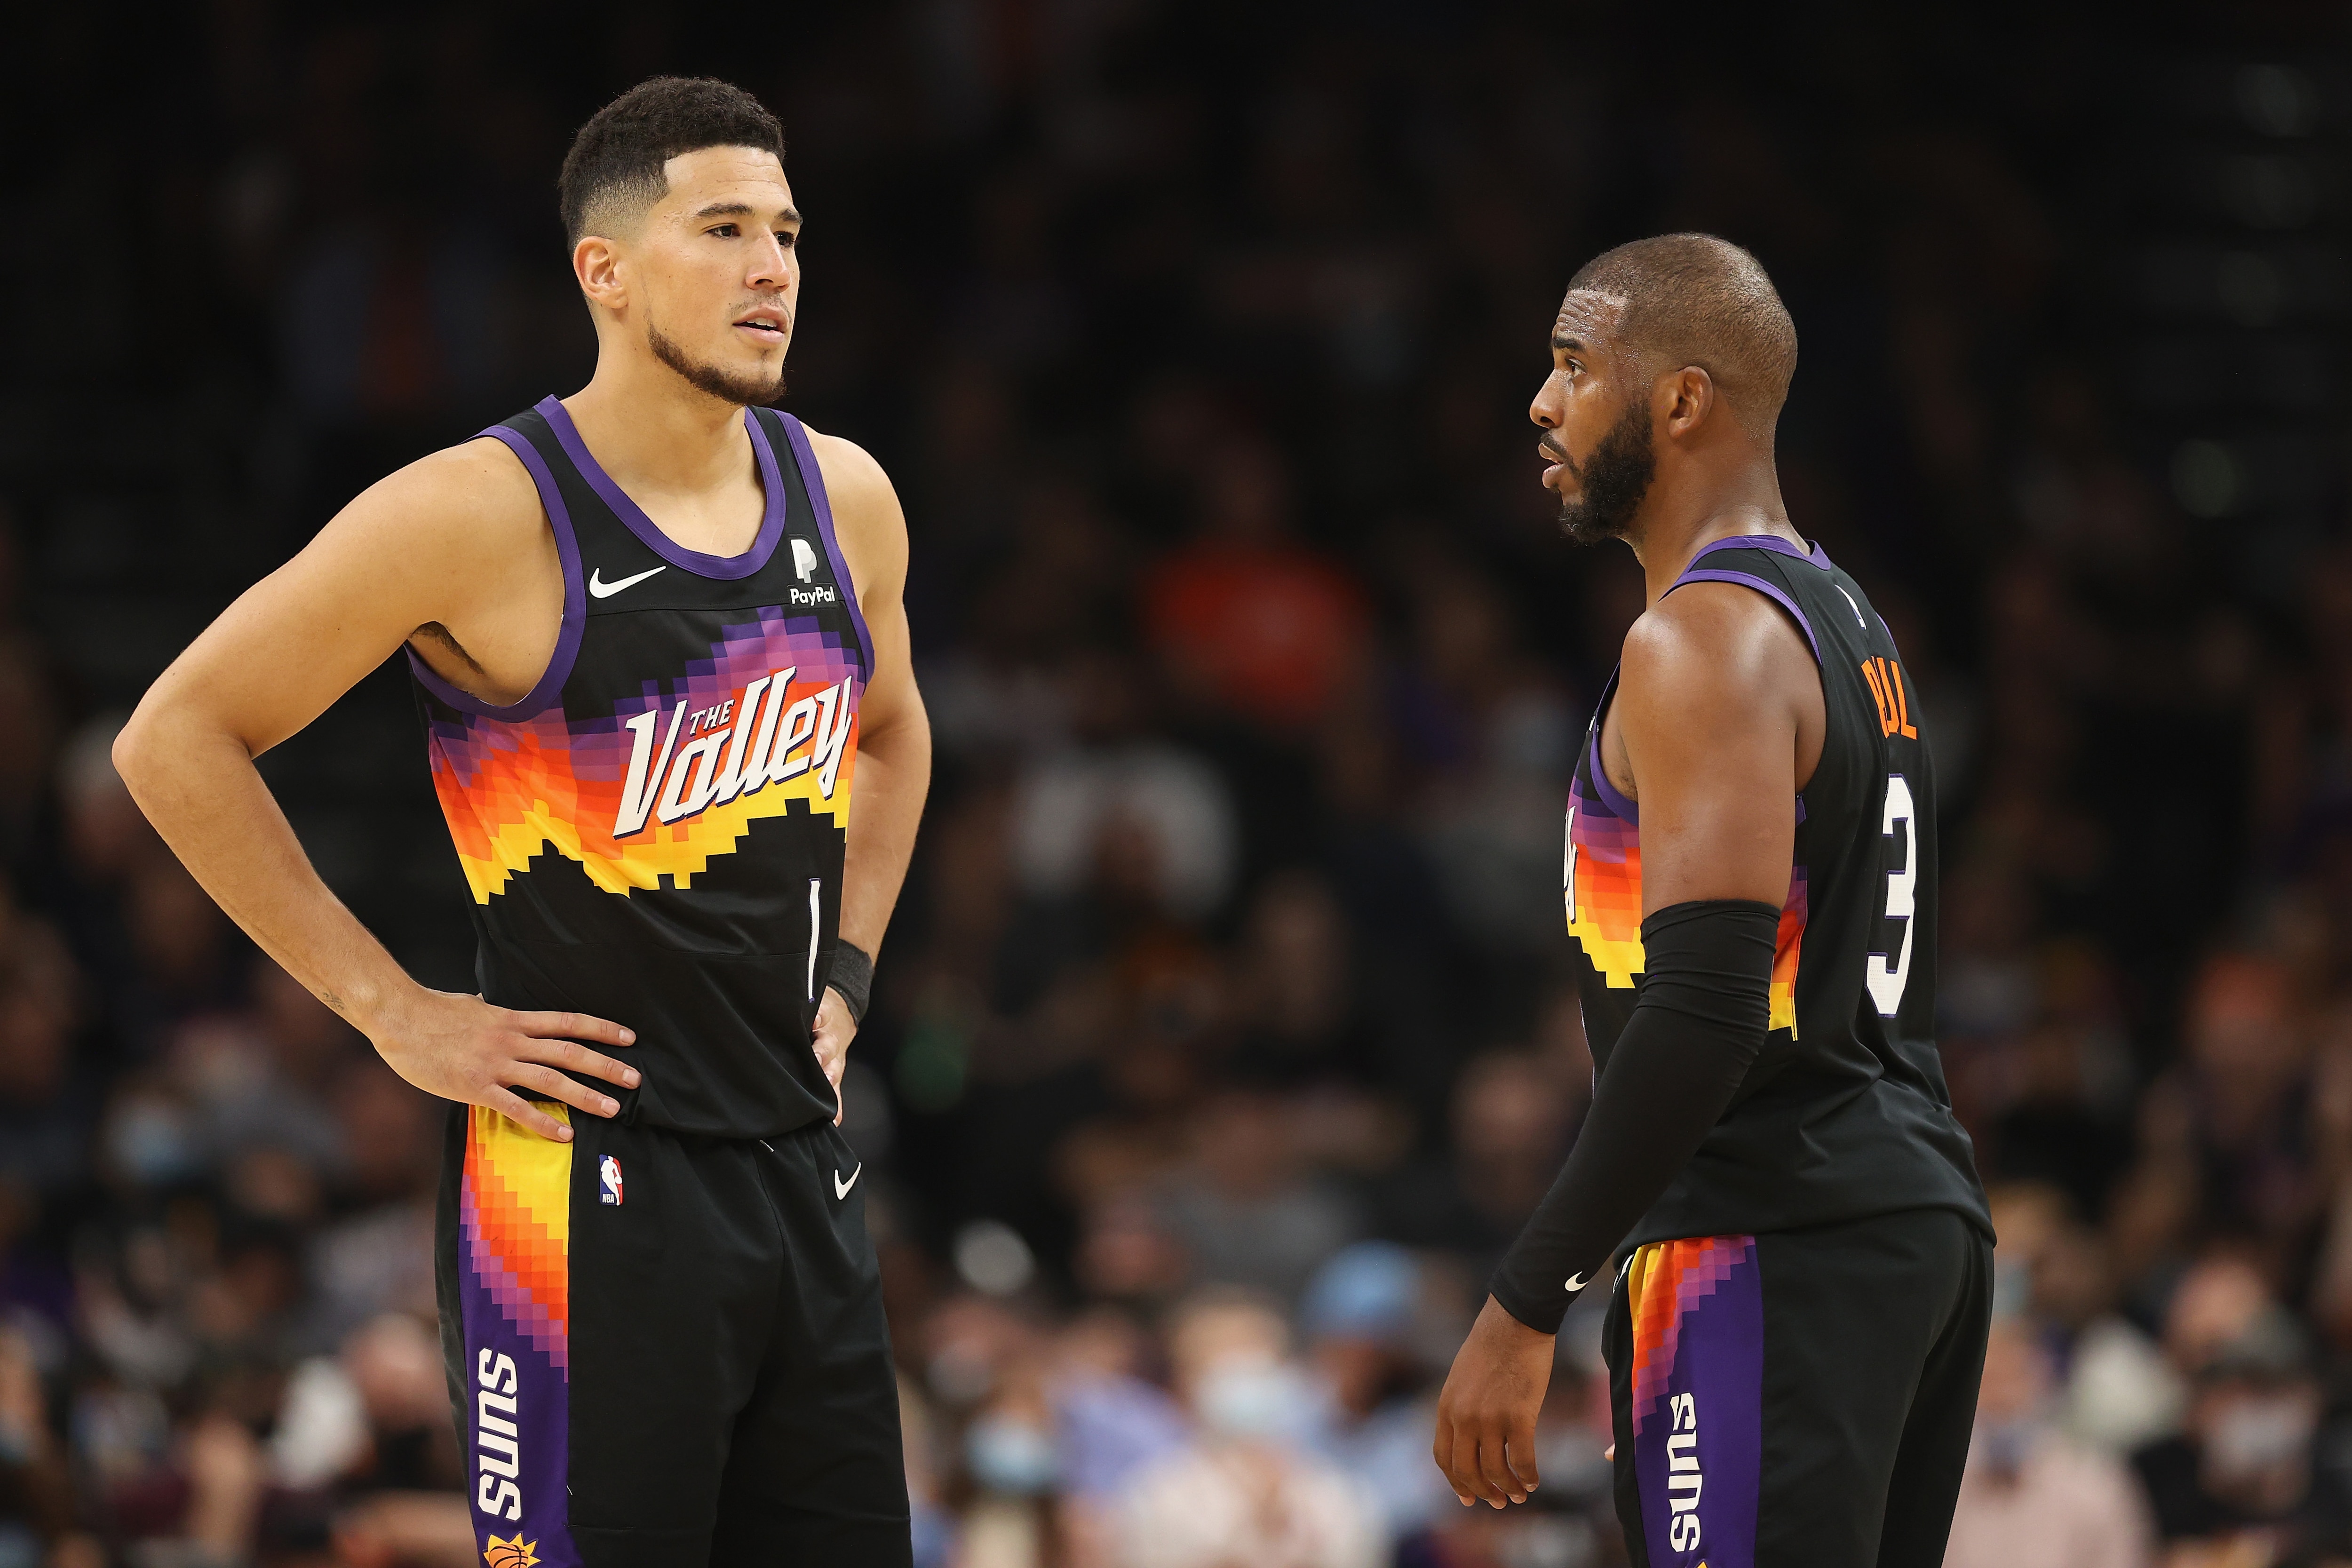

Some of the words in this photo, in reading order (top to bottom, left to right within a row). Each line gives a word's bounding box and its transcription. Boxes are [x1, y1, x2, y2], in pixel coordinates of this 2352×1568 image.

[790, 586, 835, 606] PayPal
[613, 666, 852, 840] Valley
[689, 699, 734, 735] THE
[1864, 773, 1916, 1018] 3
[807, 877, 822, 1003] 1
[602, 1194, 614, 1203] NBA
